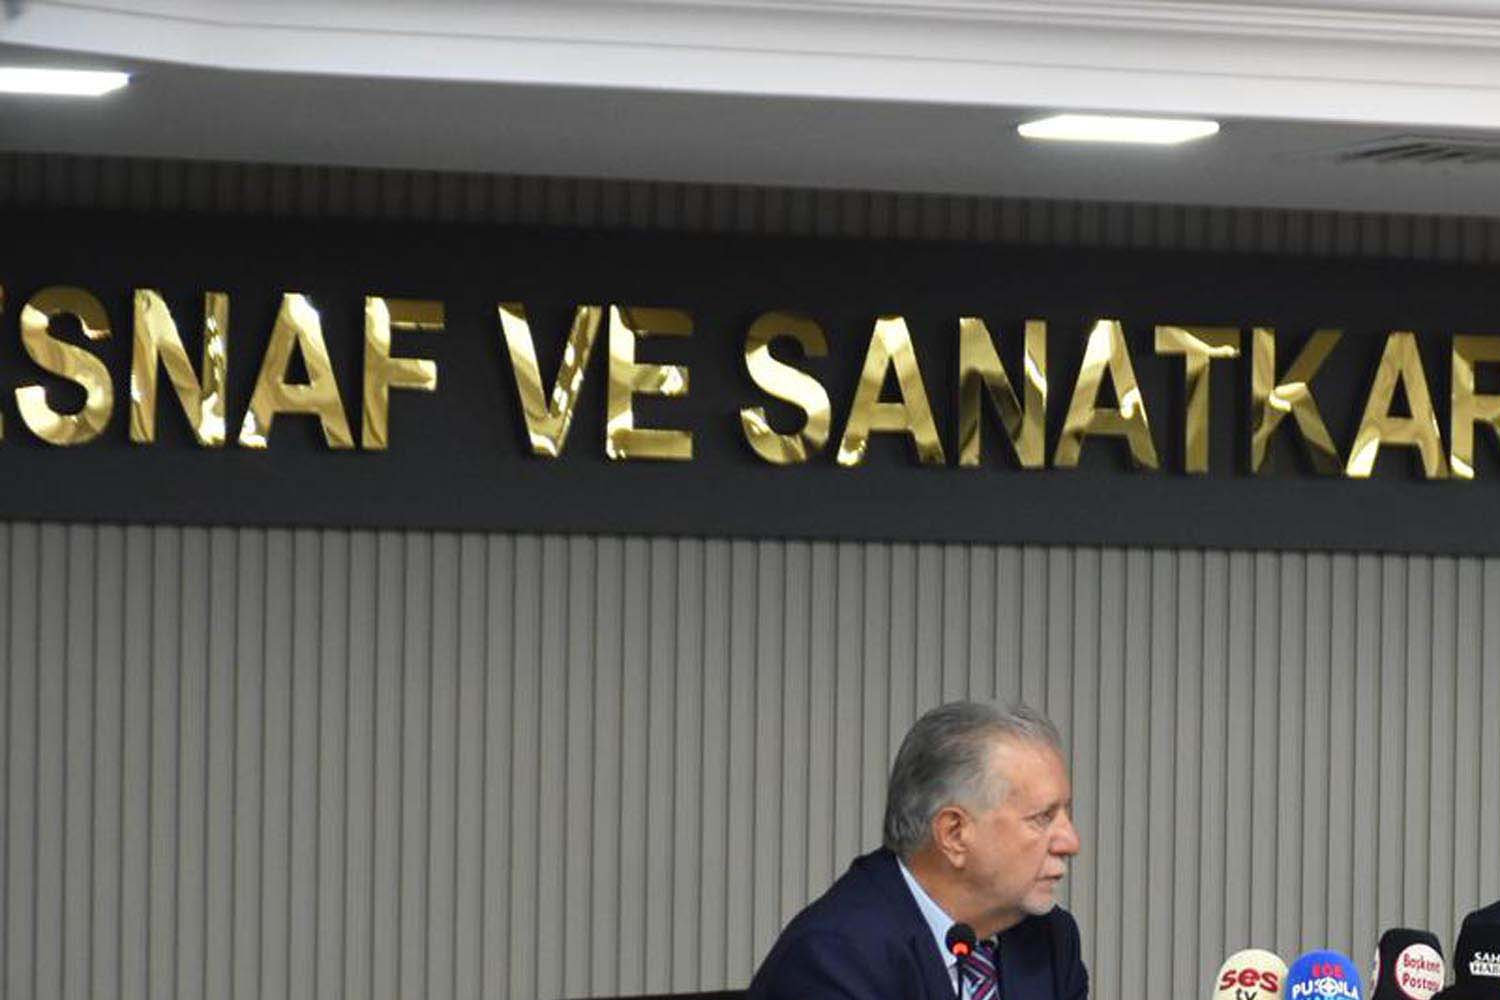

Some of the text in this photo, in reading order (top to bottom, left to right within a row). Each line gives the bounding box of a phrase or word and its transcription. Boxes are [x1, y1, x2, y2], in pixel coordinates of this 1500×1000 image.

[0, 285, 445, 450] SNAF
[498, 302, 694, 460] VE
[1219, 968, 1279, 993] ses
